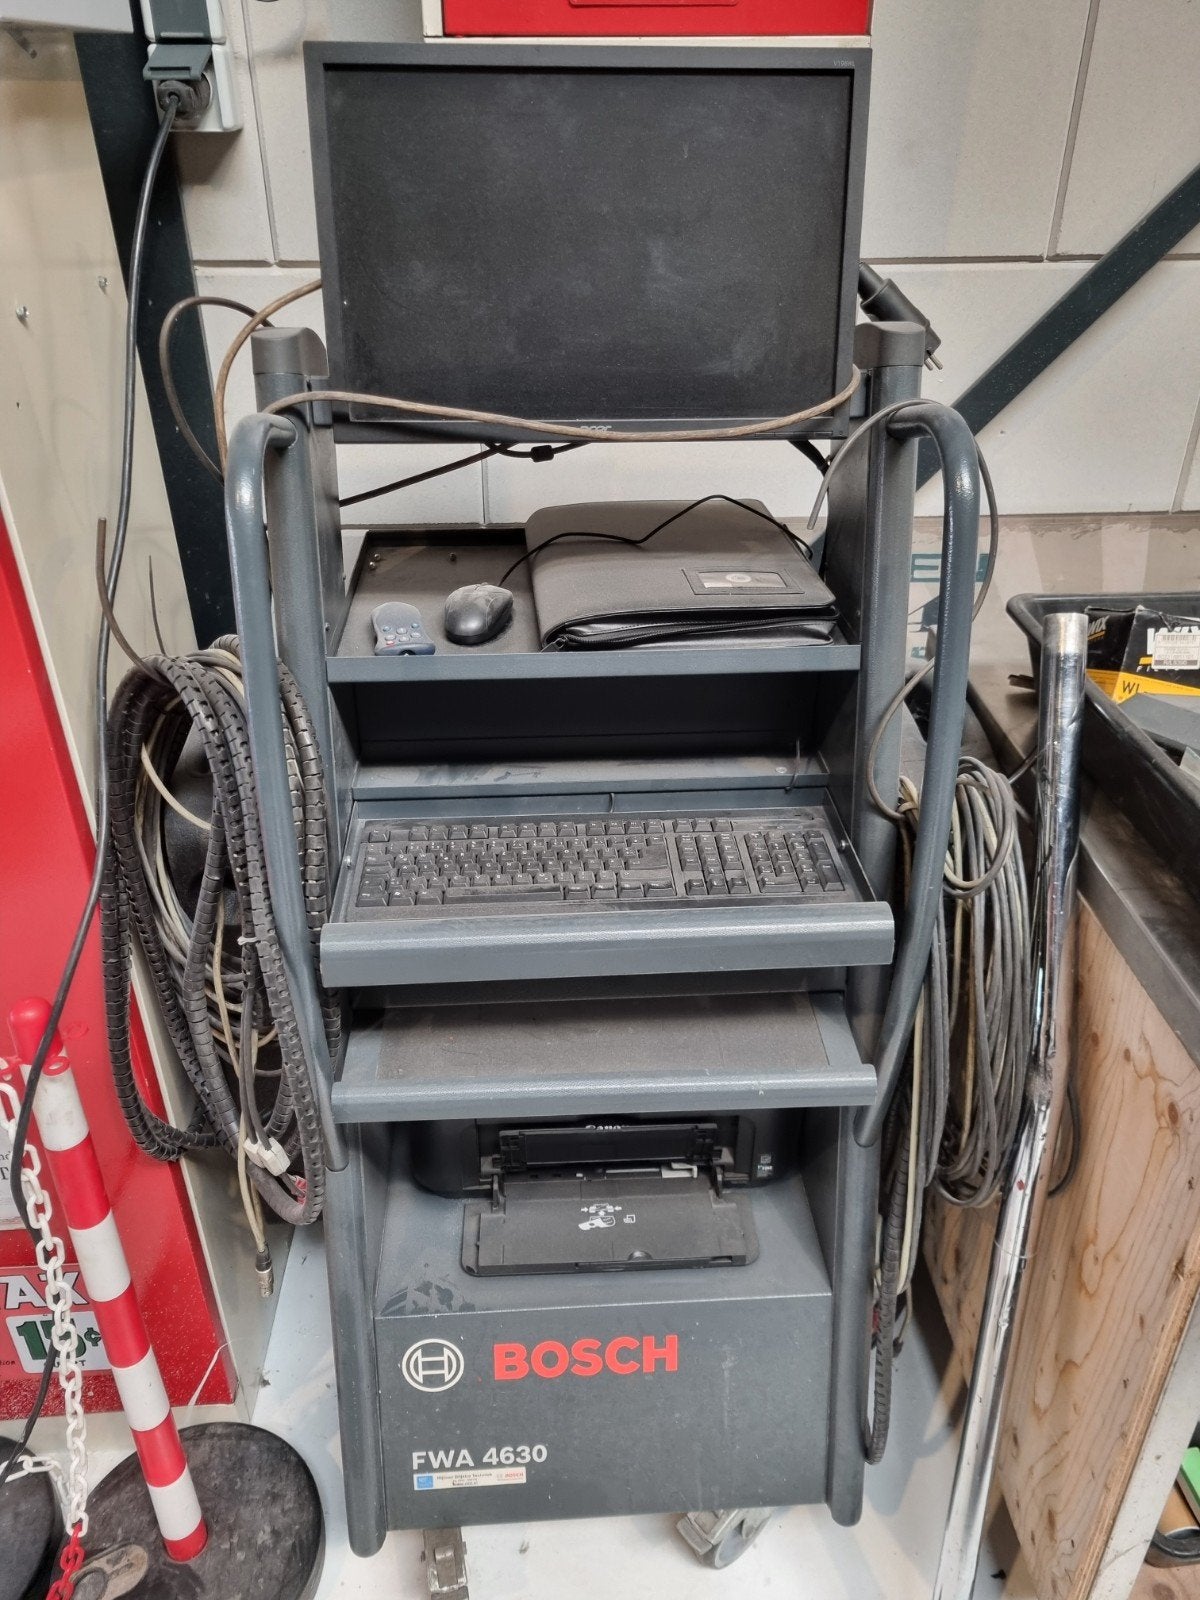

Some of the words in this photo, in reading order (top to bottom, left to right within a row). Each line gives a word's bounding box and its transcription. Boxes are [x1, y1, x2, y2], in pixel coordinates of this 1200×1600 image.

[493, 1334, 679, 1381] BOSCH
[412, 1449, 475, 1470] FWA
[482, 1444, 548, 1466] 4630
